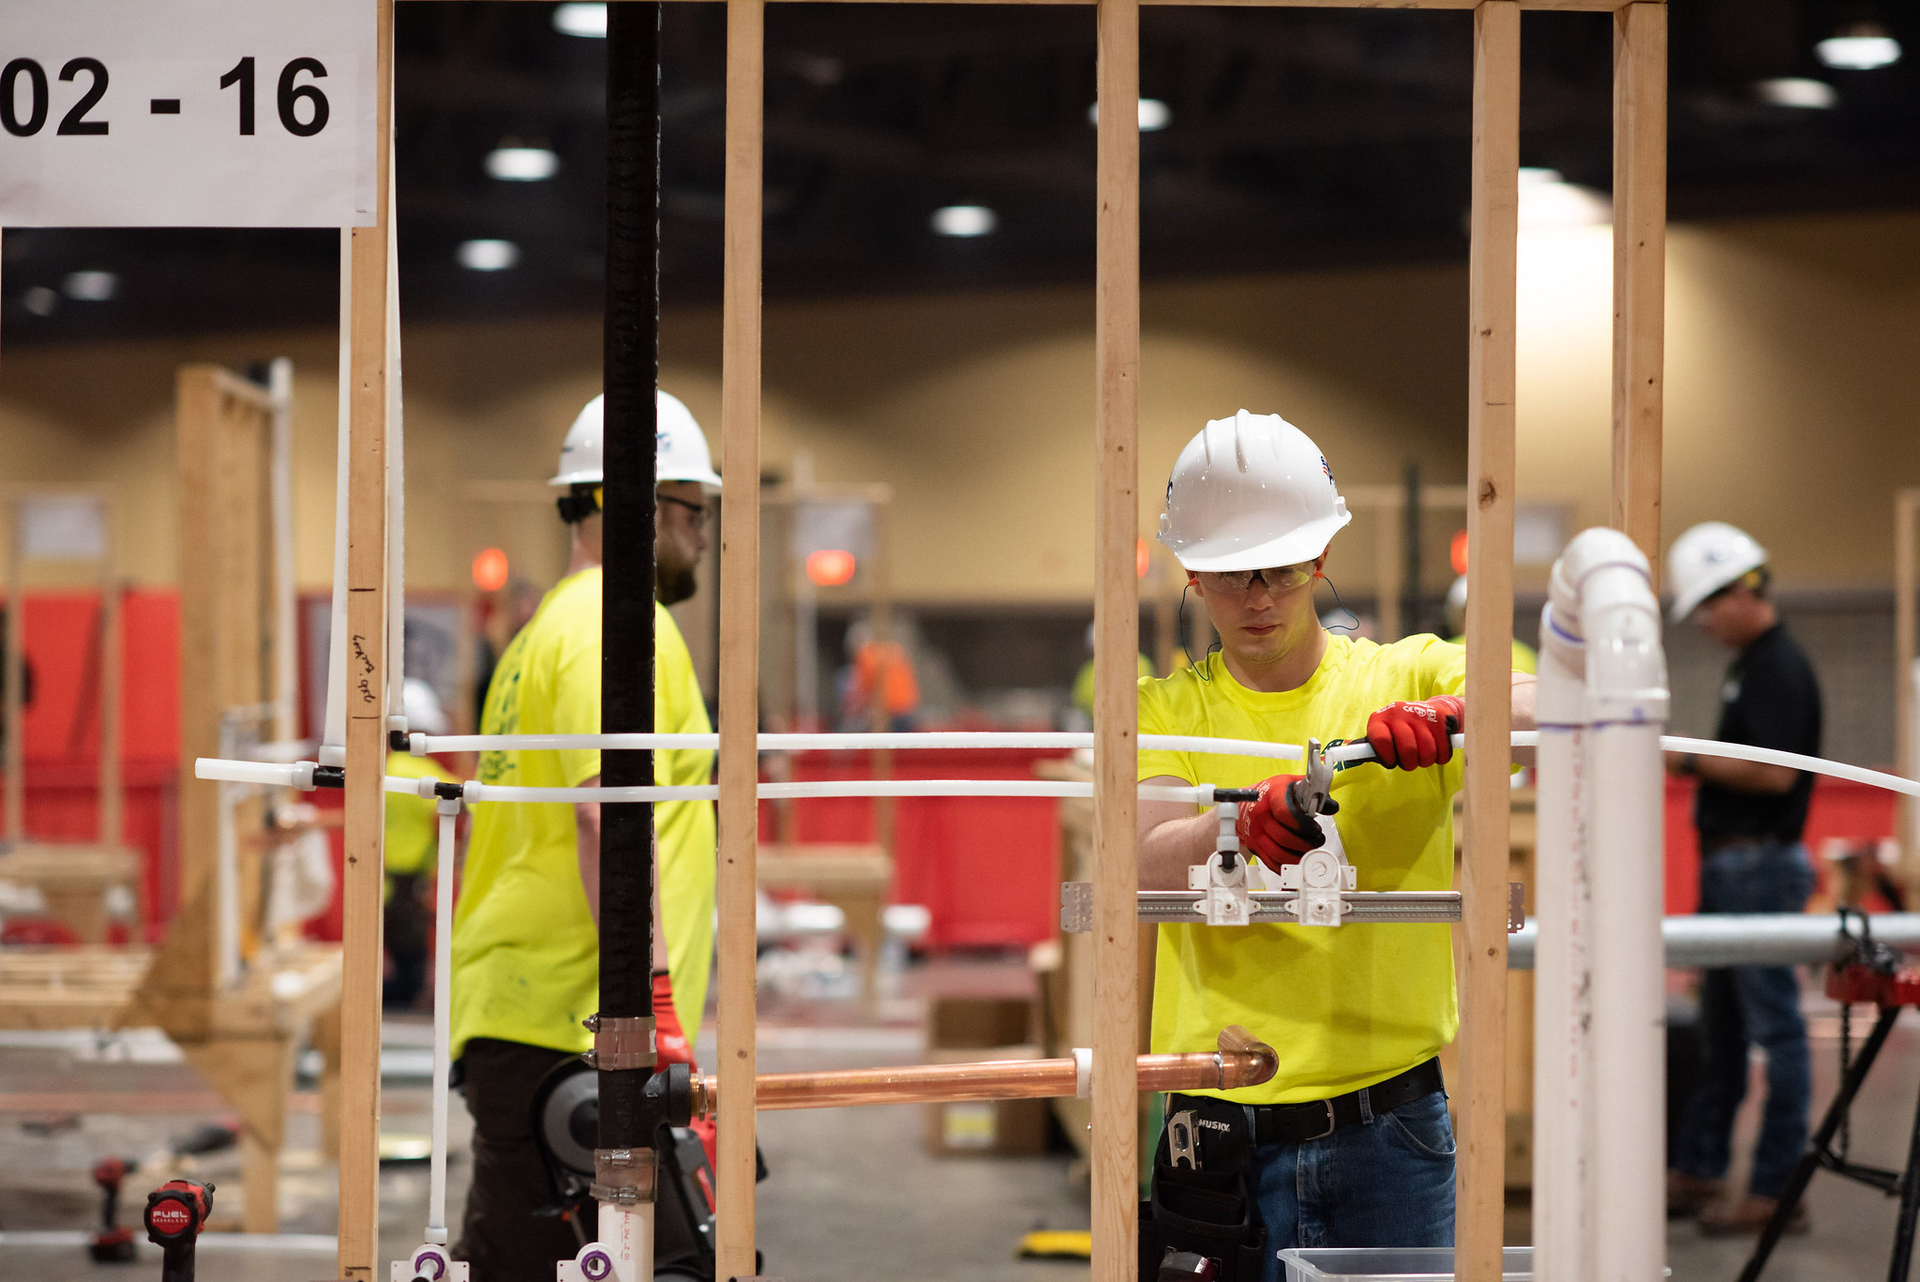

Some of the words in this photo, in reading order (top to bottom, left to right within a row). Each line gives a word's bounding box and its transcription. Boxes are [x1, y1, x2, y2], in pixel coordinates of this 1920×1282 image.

[0, 56, 110, 137] 02
[150, 98, 181, 115] -
[219, 56, 331, 137] 16
[1198, 1118, 1231, 1132] HUSKY
[153, 1210, 188, 1218] FUEL
